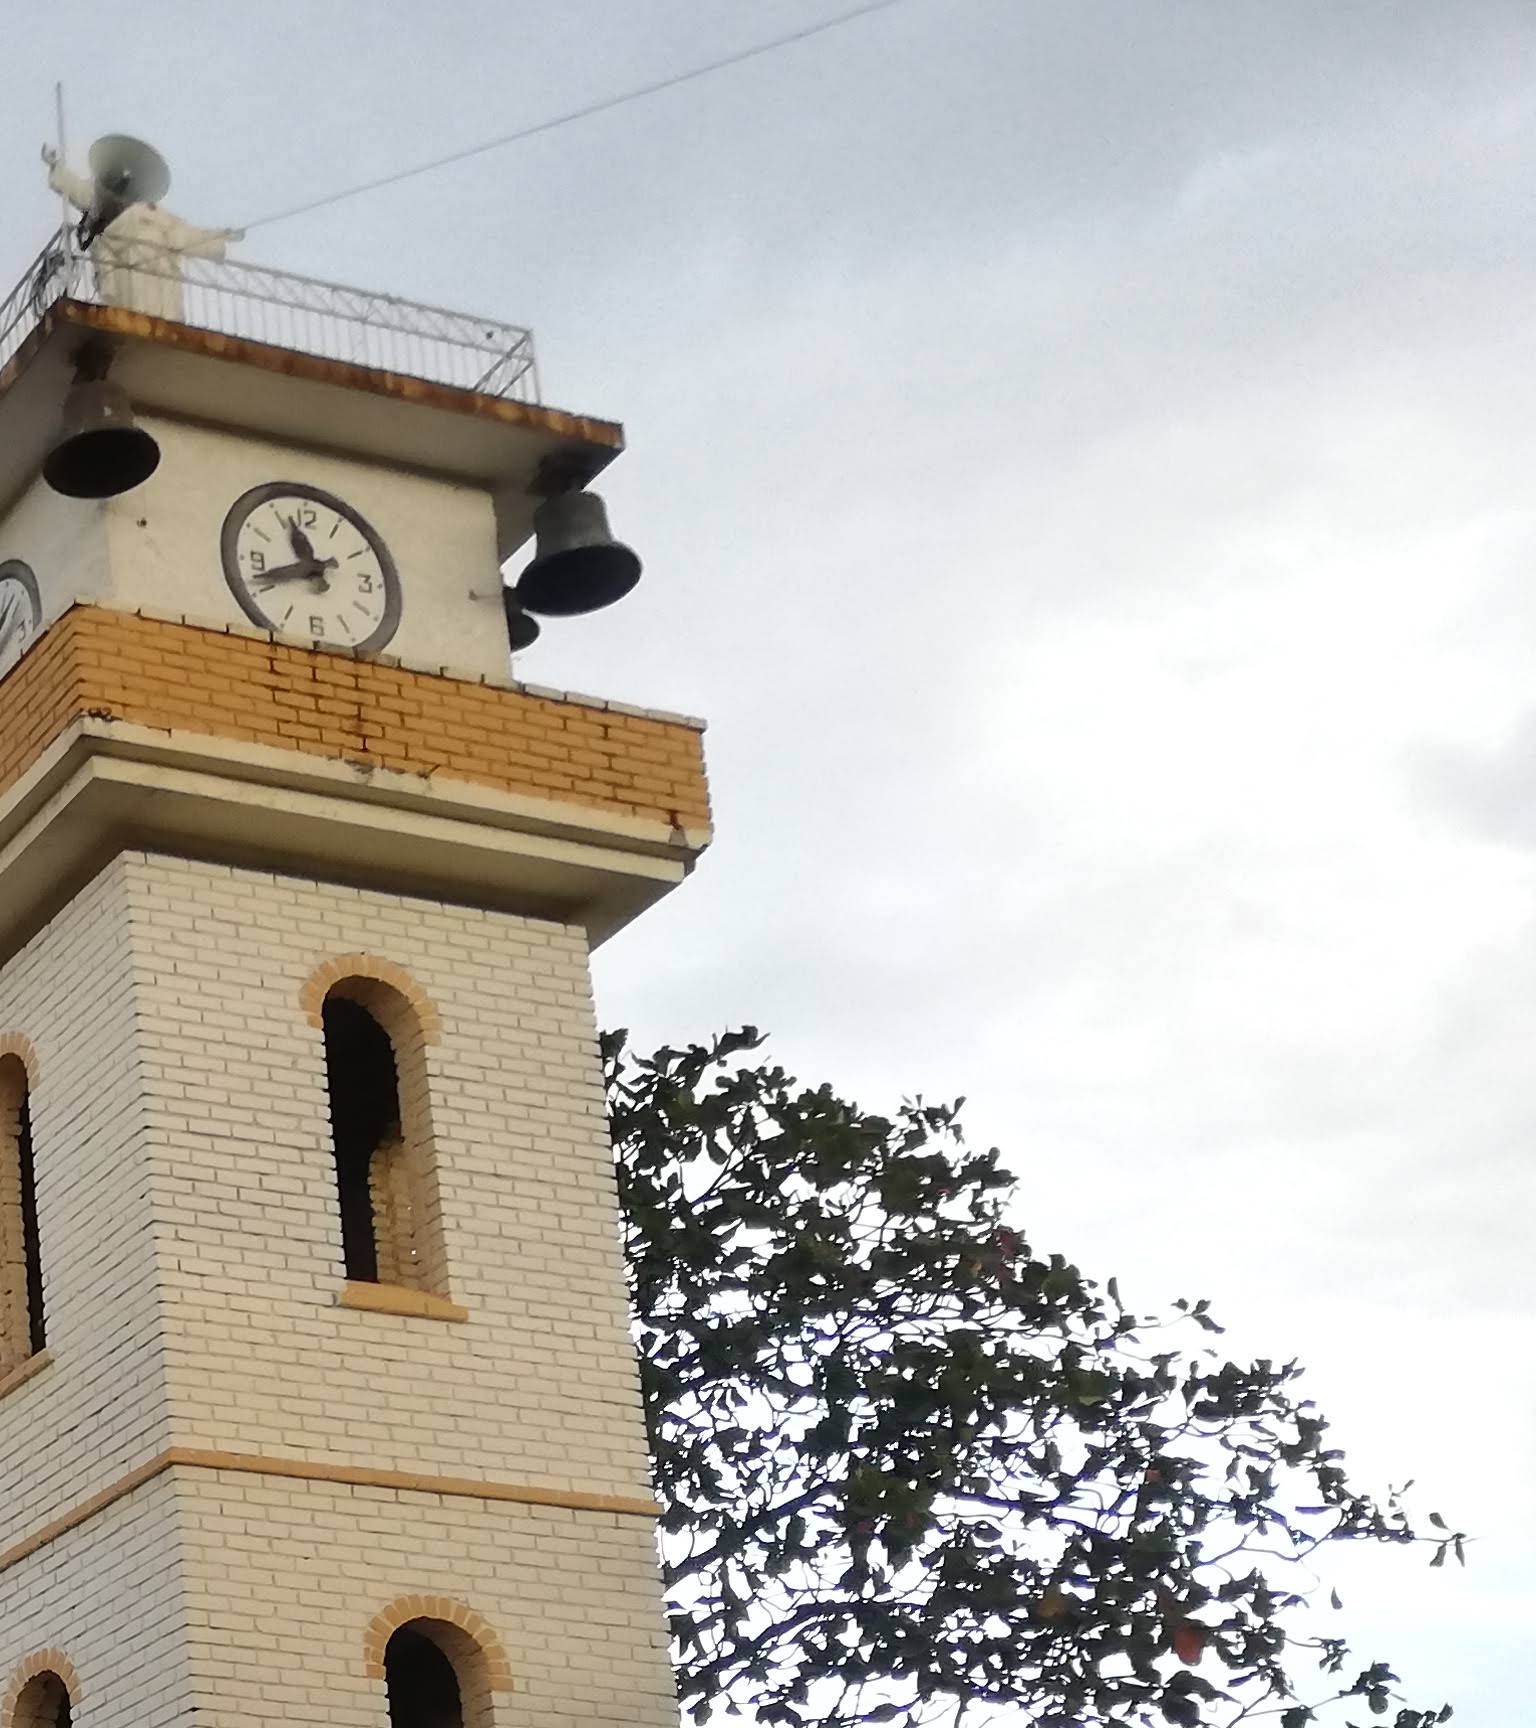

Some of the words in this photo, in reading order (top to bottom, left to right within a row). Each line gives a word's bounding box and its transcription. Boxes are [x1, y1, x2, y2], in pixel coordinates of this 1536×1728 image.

[296, 508, 317, 530] 12
[250, 550, 265, 571] 9
[357, 573, 372, 594] 3
[309, 615, 324, 637] 6
